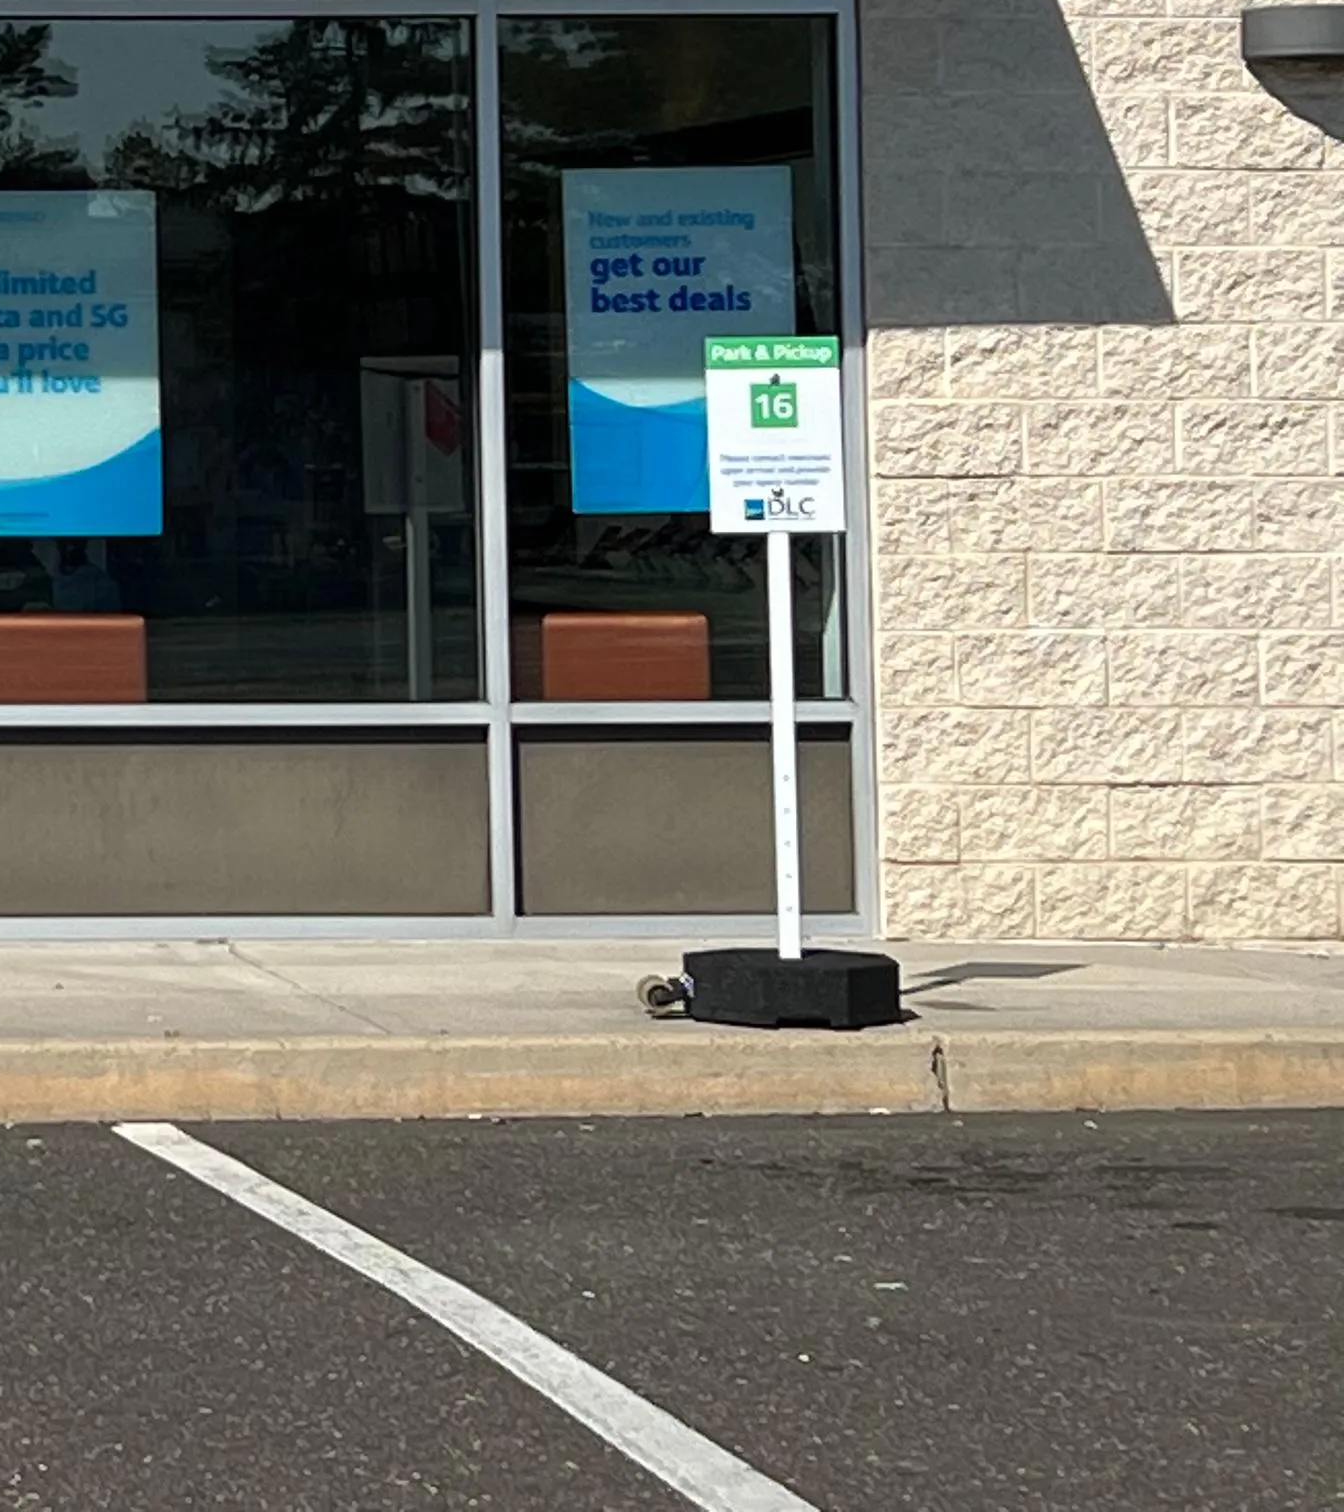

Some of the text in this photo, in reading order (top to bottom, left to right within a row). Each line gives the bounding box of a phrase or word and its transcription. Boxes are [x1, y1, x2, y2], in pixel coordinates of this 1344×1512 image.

[589, 209, 755, 230] New and existing
[590, 234, 692, 249] customers
[590, 253, 706, 284] get our
[591, 284, 752, 313] best deals
[28, 302, 83, 328] and
[18, 336, 90, 367] price
[712, 344, 832, 364] Park & Pickup
[41, 369, 101, 394] love
[754, 393, 793, 419] 16
[767, 497, 815, 516] DLC
